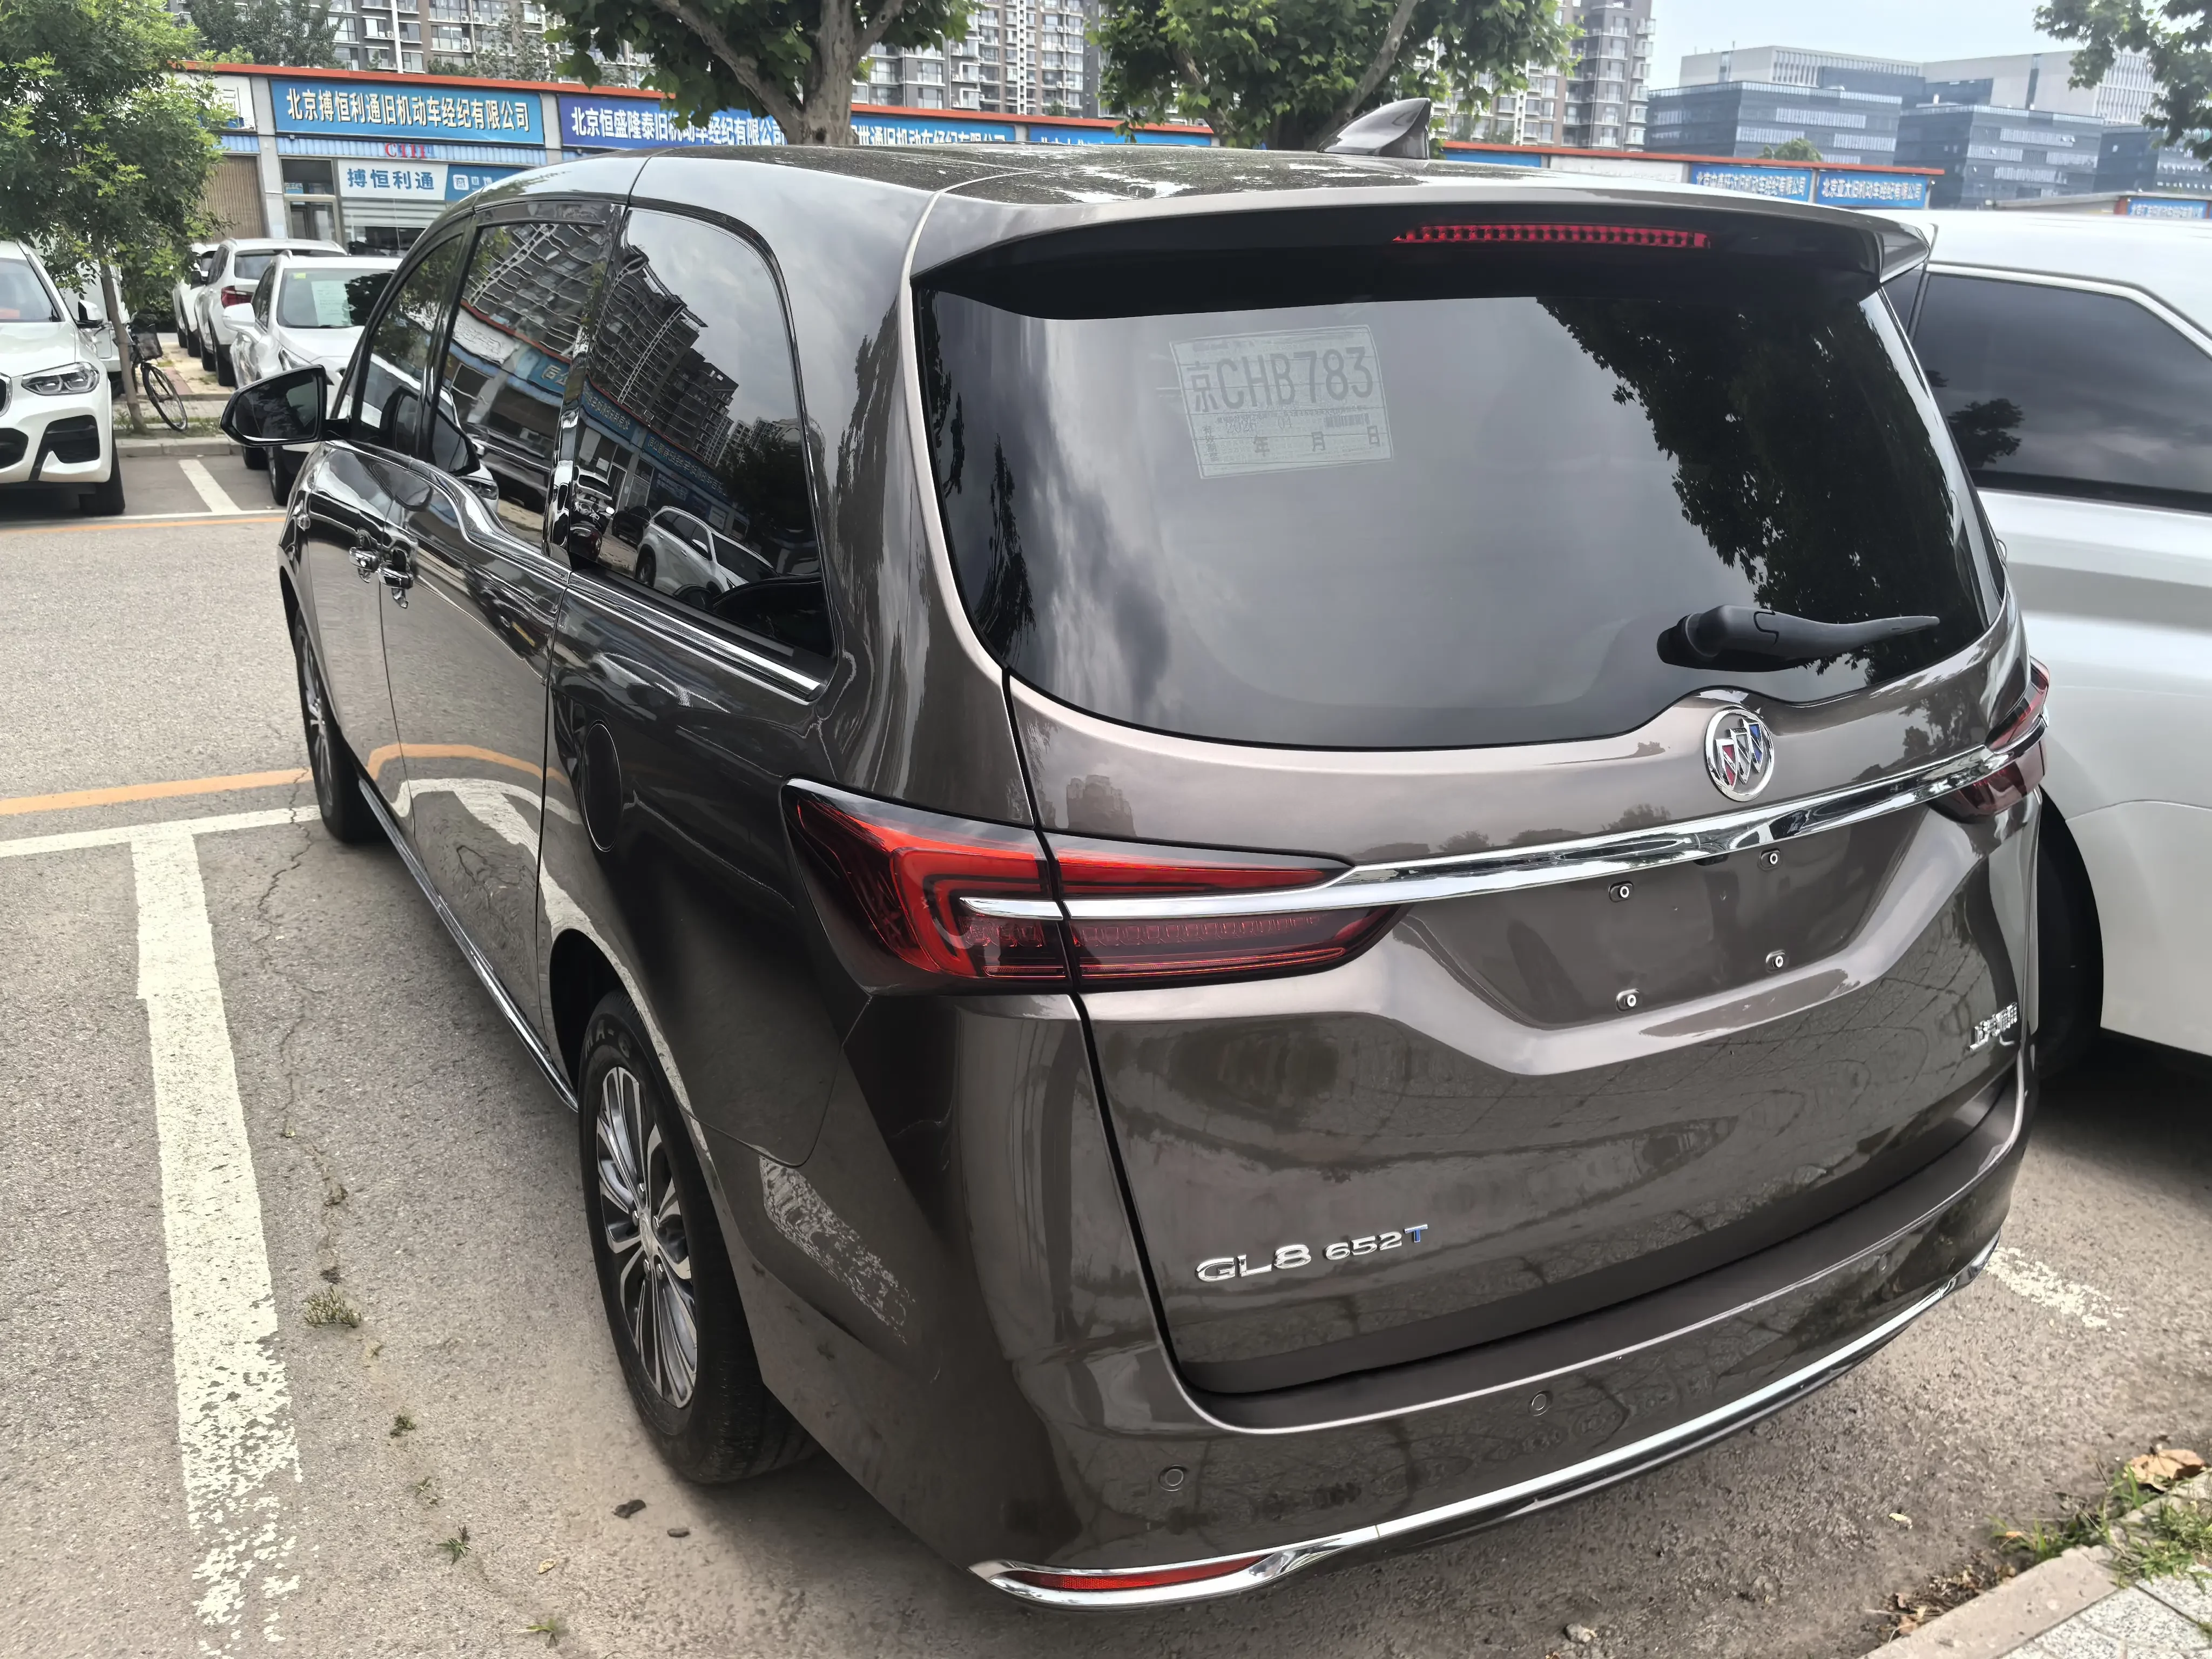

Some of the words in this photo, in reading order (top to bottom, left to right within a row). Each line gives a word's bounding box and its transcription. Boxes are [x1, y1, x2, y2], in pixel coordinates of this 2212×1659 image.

[286, 88, 529, 131] 北京搏恒利通旧机动车经纪有限公司
[347, 167, 434, 190] 搏恒利通
[1187, 346, 1373, 413] 京CHB783
[1253, 435, 1270, 457] 年
[1311, 431, 1325, 452] 月
[1367, 426, 1381, 447] 日
[1195, 1243, 1312, 1282] GL8
[1323, 1223, 1428, 1260] 652T
